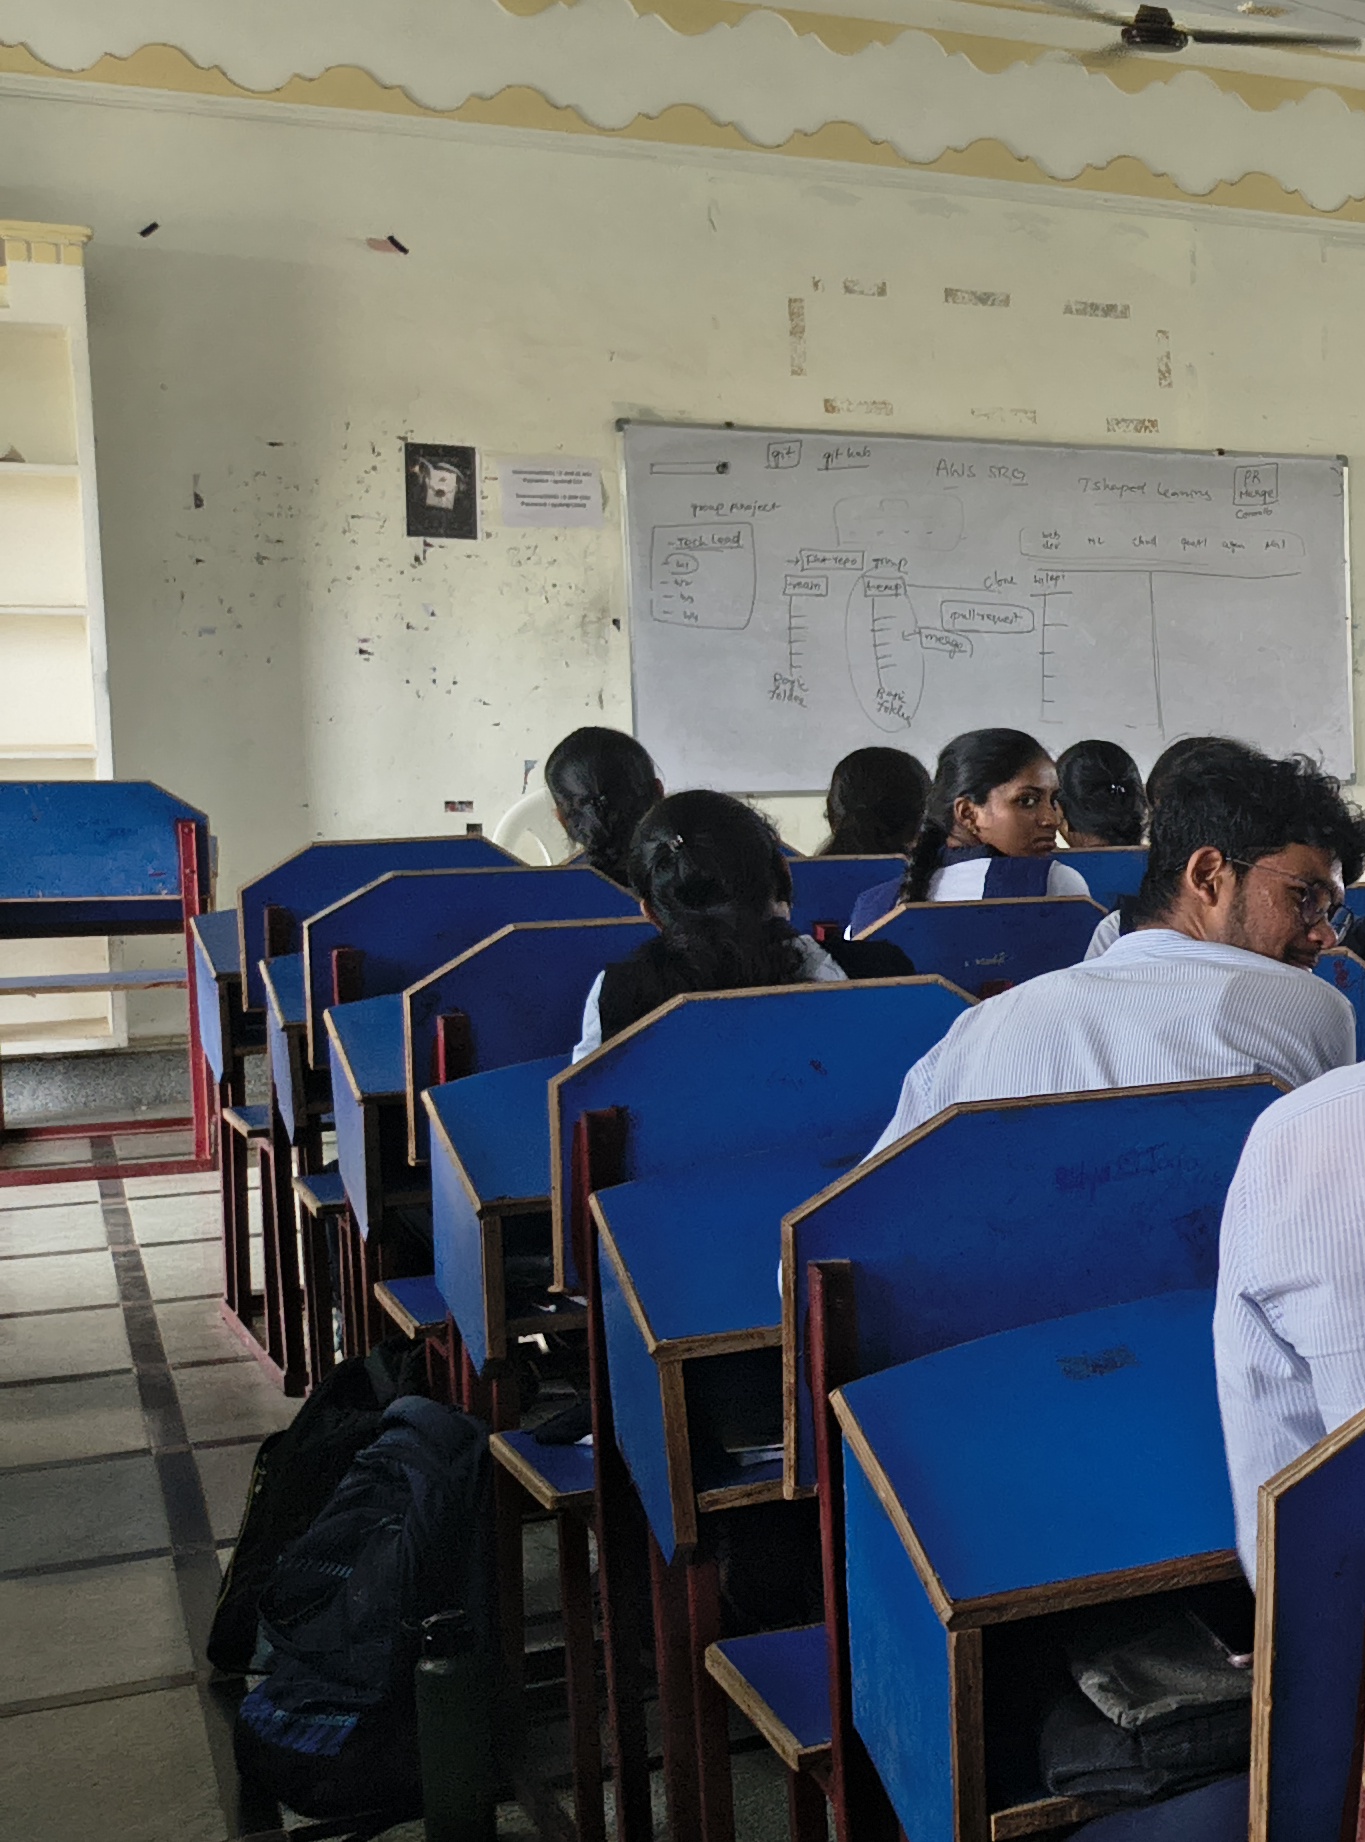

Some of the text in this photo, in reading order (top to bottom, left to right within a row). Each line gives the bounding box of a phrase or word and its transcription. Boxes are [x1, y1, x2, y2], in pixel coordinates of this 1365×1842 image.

[771, 446, 796, 468] git
[935, 457, 976, 479] AWS
[1244, 470, 1261, 488] PR
